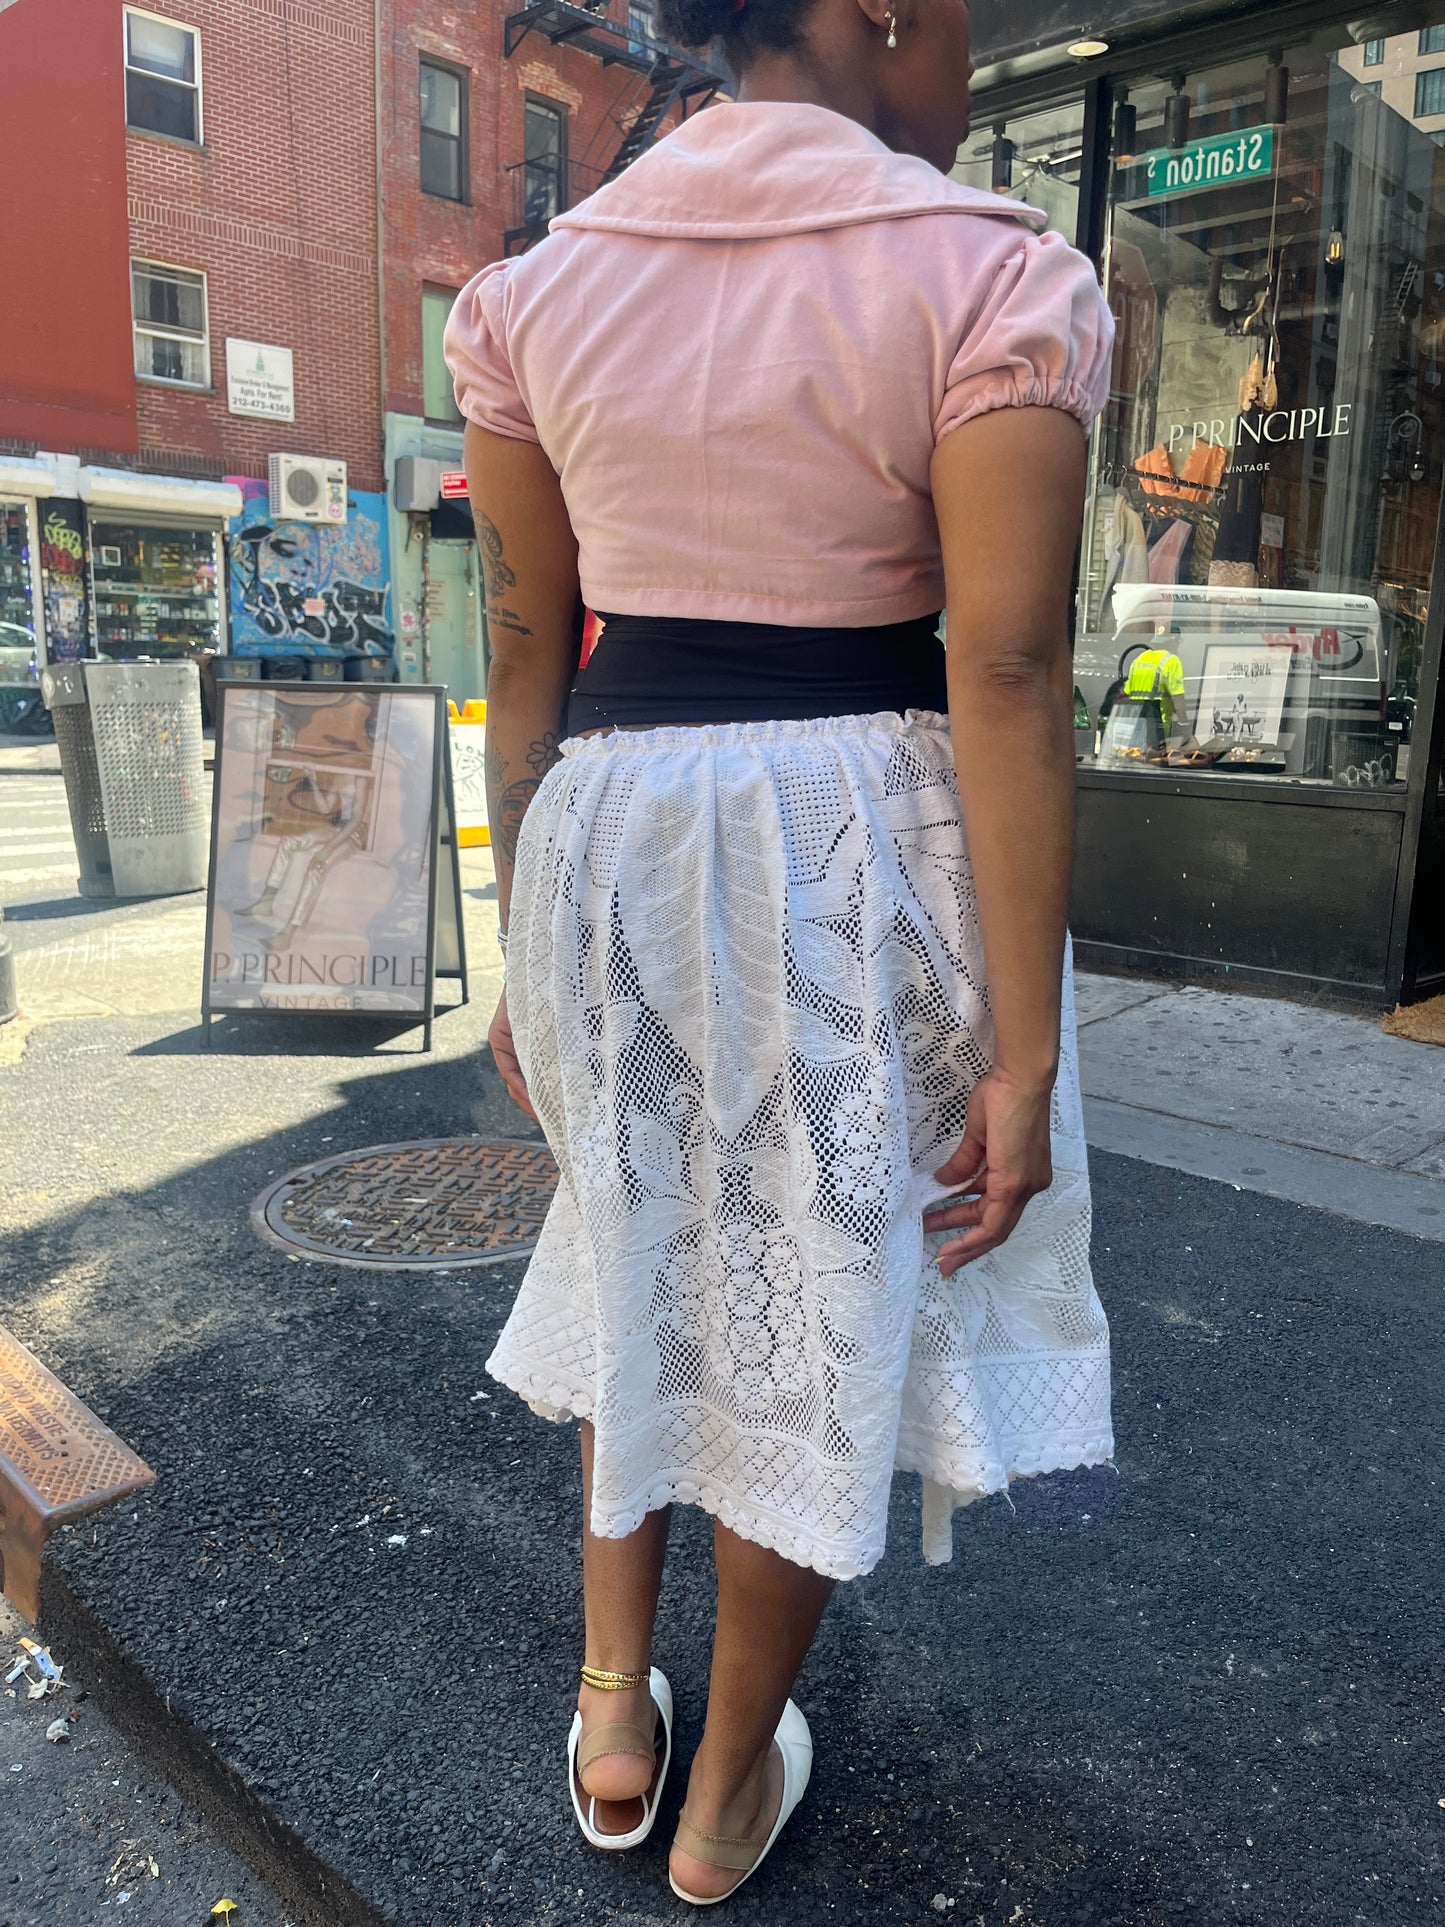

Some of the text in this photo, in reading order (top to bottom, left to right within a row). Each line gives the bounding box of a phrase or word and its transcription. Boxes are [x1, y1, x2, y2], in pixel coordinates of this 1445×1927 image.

[1191, 404, 1351, 451] PRINCIPLE
[1225, 462, 1271, 475] VINTAGE
[212, 952, 427, 987] P. PRINCIPLE
[258, 994, 362, 1010] VINTAGE
[26, 1402, 69, 1437] WASTE
